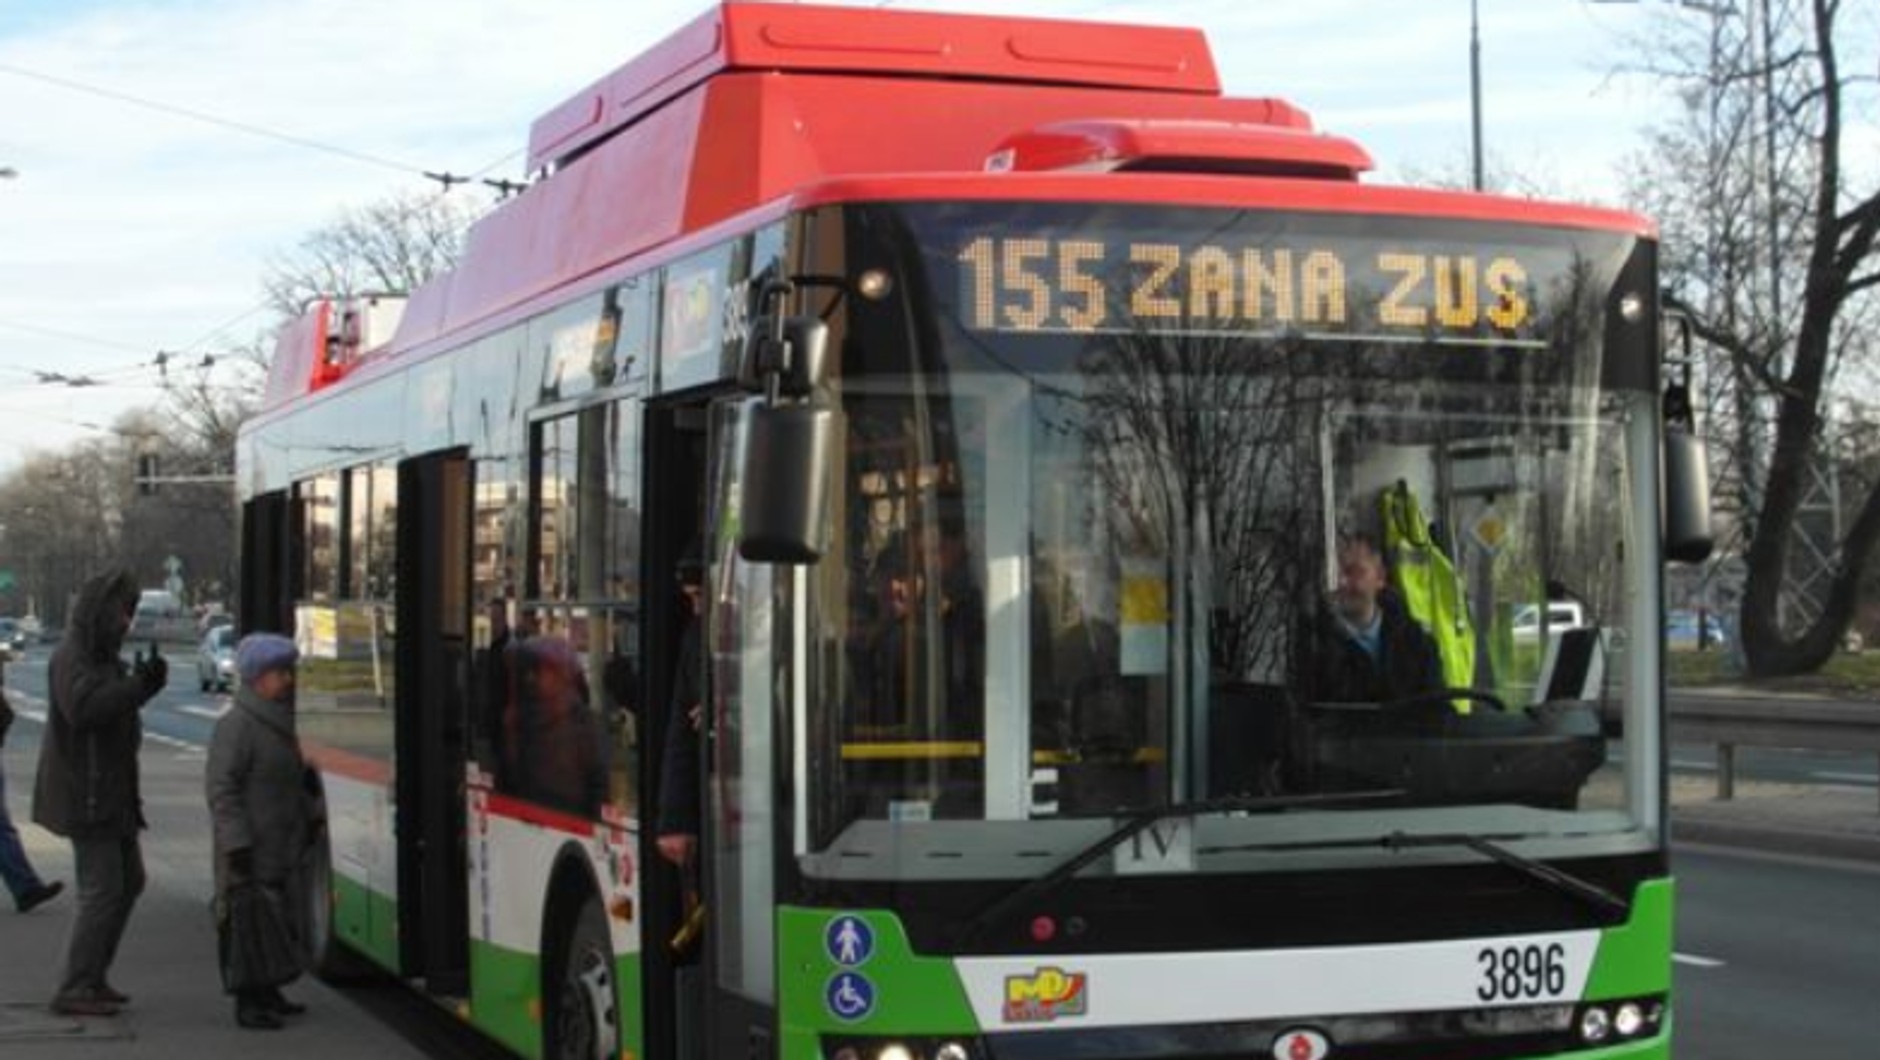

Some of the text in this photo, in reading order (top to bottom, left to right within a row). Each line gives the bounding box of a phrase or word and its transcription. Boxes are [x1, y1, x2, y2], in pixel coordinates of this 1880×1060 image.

[958, 237, 1529, 331] 155 ZANA ZUS
[1478, 942, 1565, 1002] 3896
